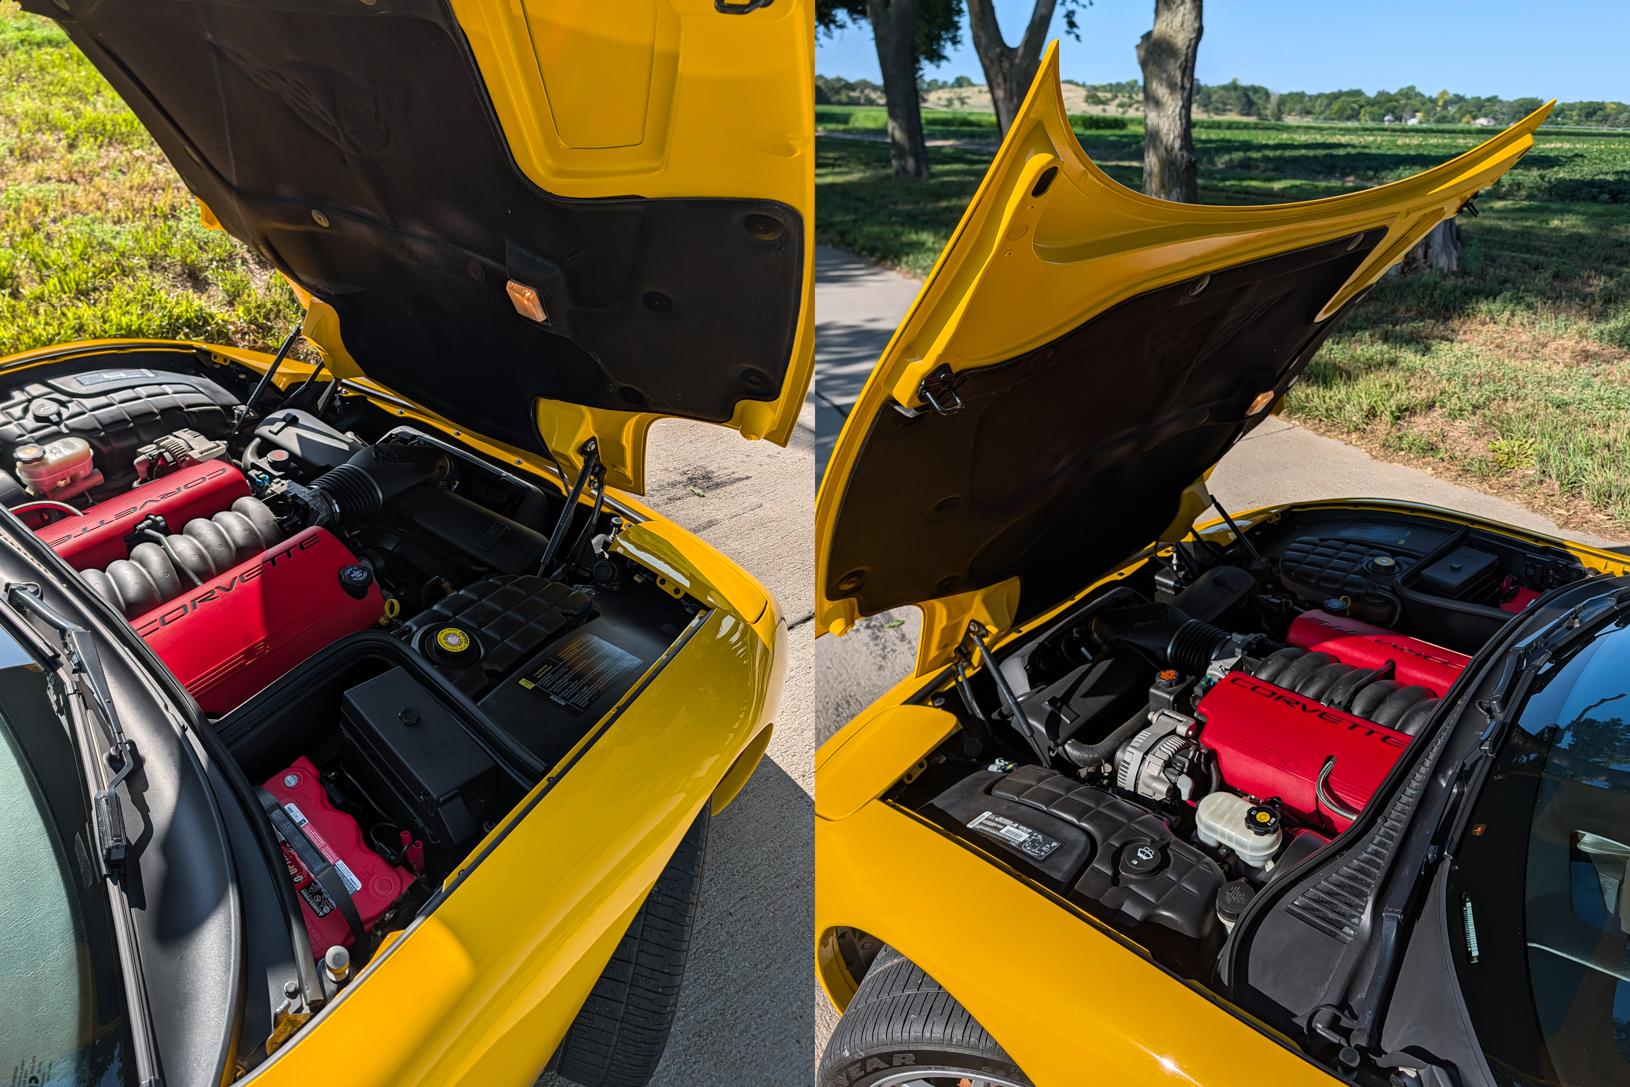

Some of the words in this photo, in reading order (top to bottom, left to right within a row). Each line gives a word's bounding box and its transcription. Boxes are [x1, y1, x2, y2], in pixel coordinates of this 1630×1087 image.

[48, 467, 228, 549] CORVETTE
[136, 534, 321, 638] CORVETTE
[1230, 677, 1408, 749] CORVETTE
